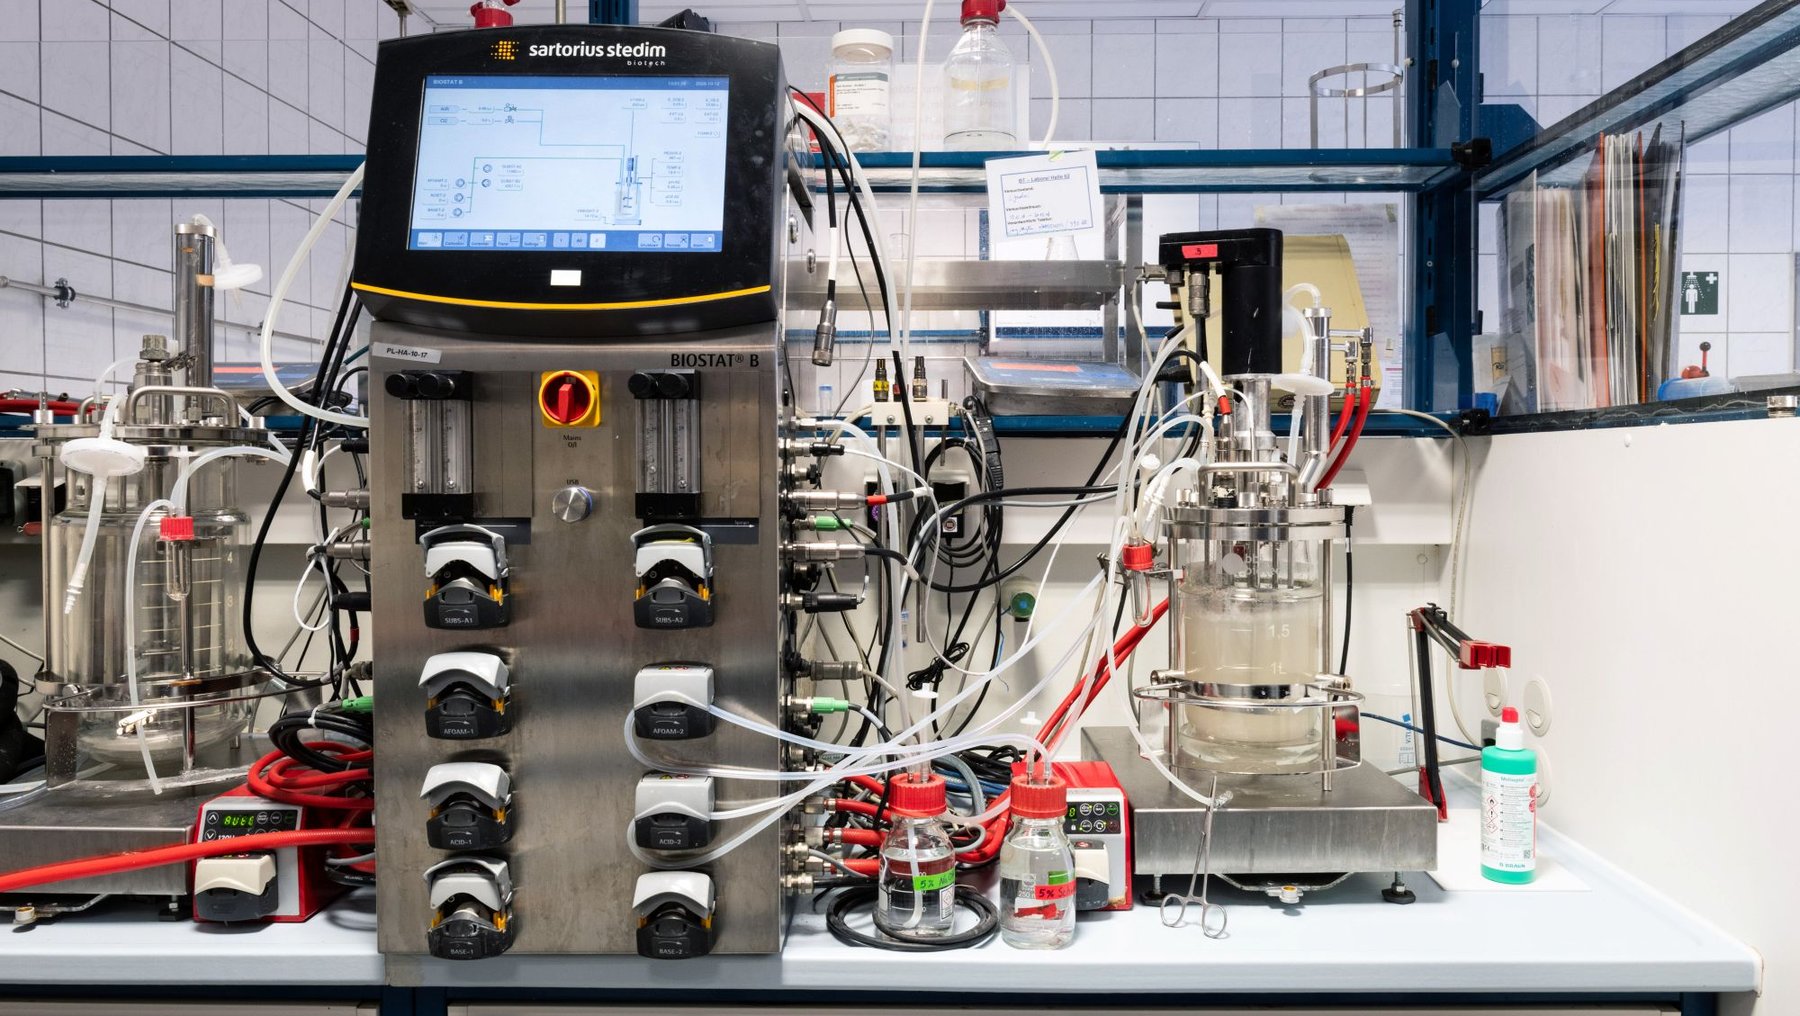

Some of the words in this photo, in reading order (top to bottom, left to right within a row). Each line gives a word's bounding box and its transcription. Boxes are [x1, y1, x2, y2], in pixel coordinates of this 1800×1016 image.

[529, 41, 604, 57] sartorius
[606, 41, 666, 57] stedim
[386, 347, 428, 359] PL-HA-10-17
[671, 353, 744, 367] BIOSTAT®
[750, 354, 760, 367] B
[227, 551, 233, 564] 4
[227, 595, 233, 608] 3
[652, 727, 685, 735] AFOAM-2
[1039, 888, 1055, 899] 5%
